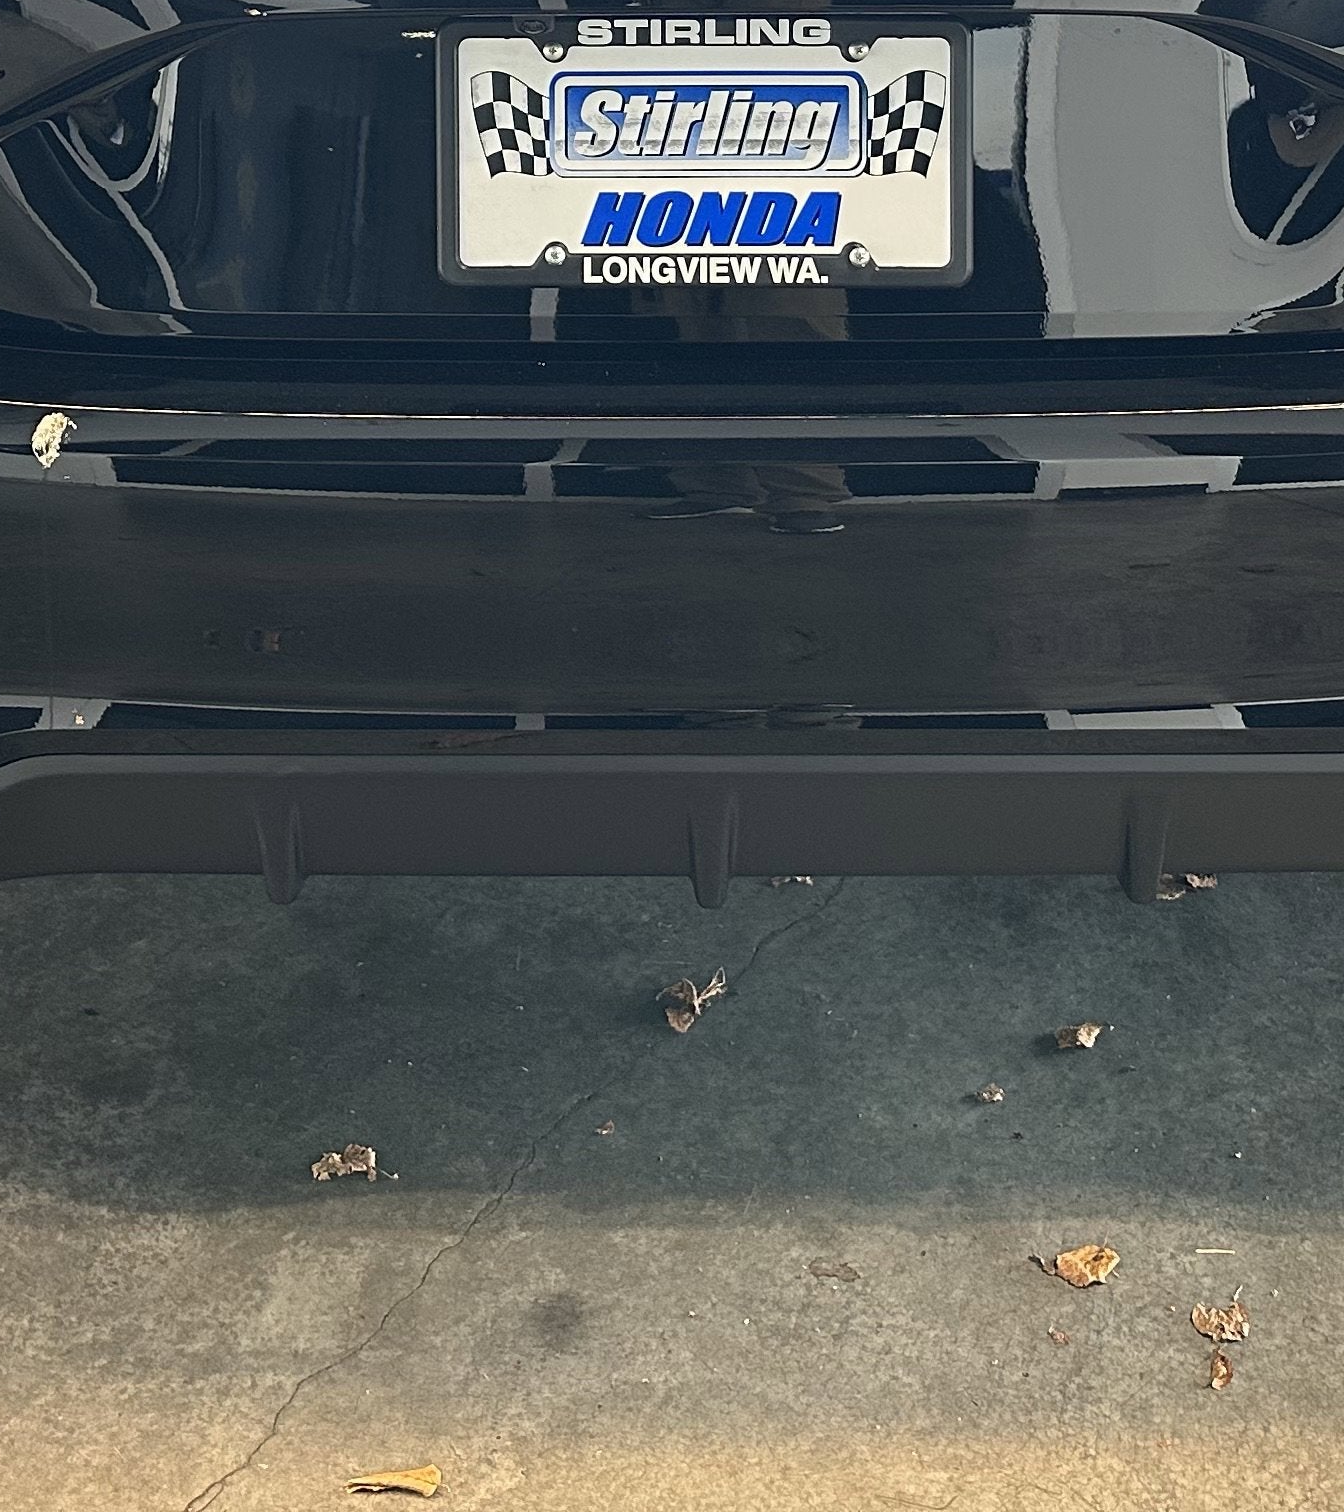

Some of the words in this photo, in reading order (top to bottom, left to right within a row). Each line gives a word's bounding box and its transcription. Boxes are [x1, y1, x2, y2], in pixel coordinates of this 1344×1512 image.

[577, 19, 831, 45] STIRLING
[574, 90, 839, 171] Stirling
[581, 191, 842, 247] HONDA
[583, 256, 768, 284] LONGVIEW
[769, 256, 829, 284] WA.
